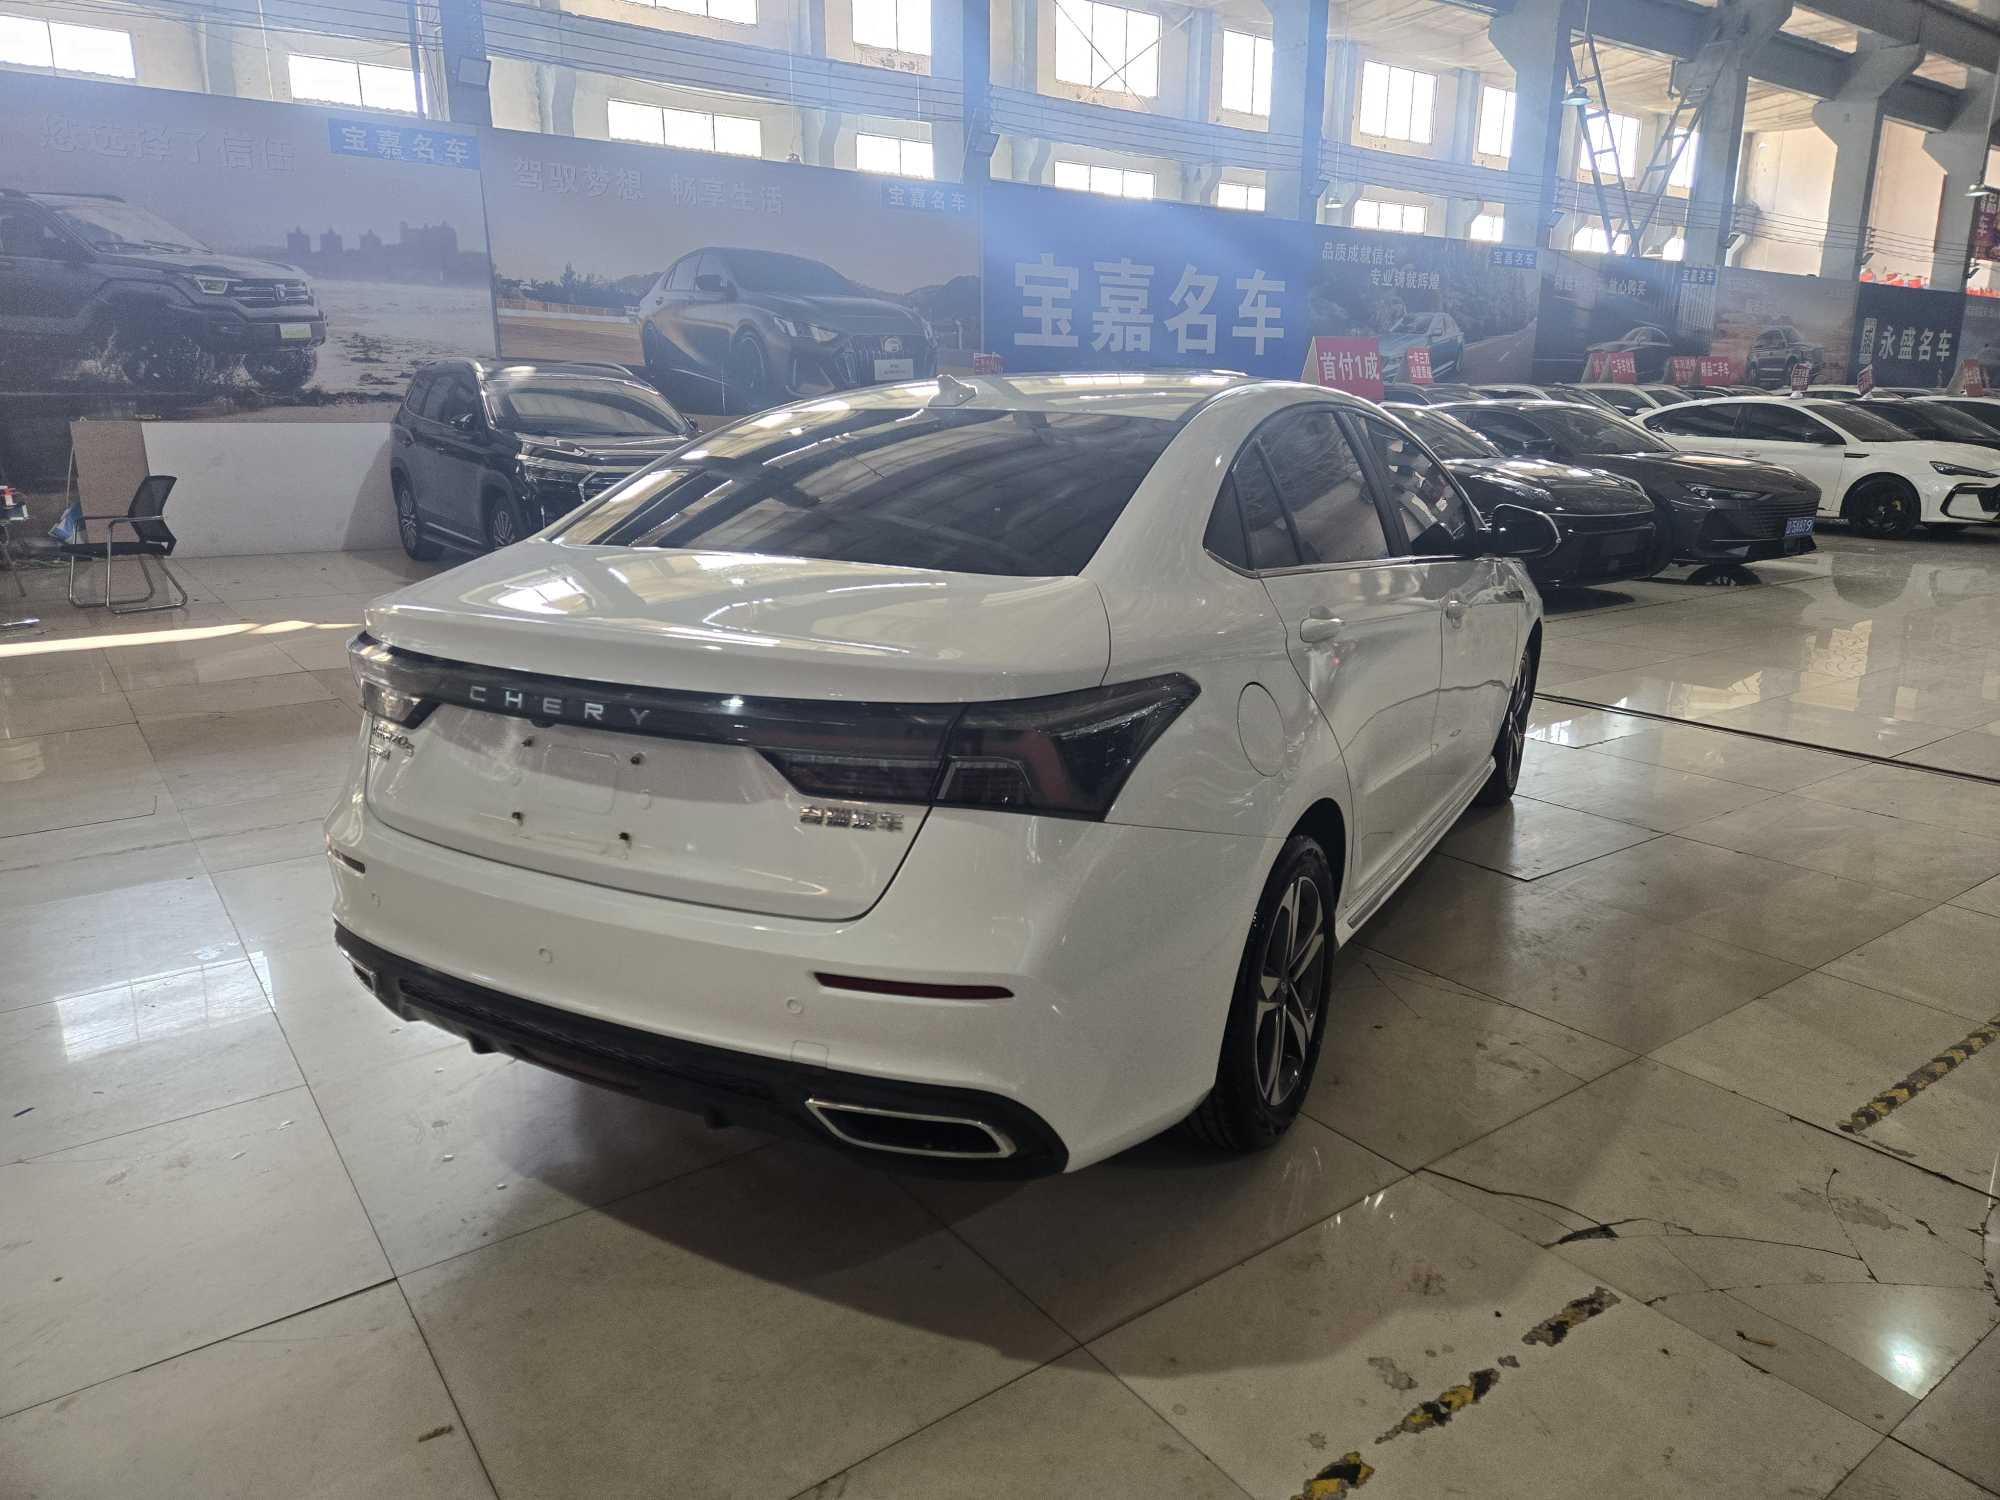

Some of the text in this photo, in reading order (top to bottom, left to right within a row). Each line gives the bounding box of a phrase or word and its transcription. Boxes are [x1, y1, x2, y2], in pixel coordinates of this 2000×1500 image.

[341, 125, 471, 164] 宝嘉名车
[511, 158, 786, 217] 驾驭梦想 畅享生活
[887, 184, 967, 212] 宝嘉名车
[1321, 241, 1396, 265] 品质成就信任
[1369, 267, 1441, 291] 专业铸就辉煌
[1013, 252, 1287, 356] 宝嘉名车
[1879, 325, 1953, 363] 永盛名车
[1319, 351, 1380, 381] 首付1成
[469, 686, 651, 727] CHERY
